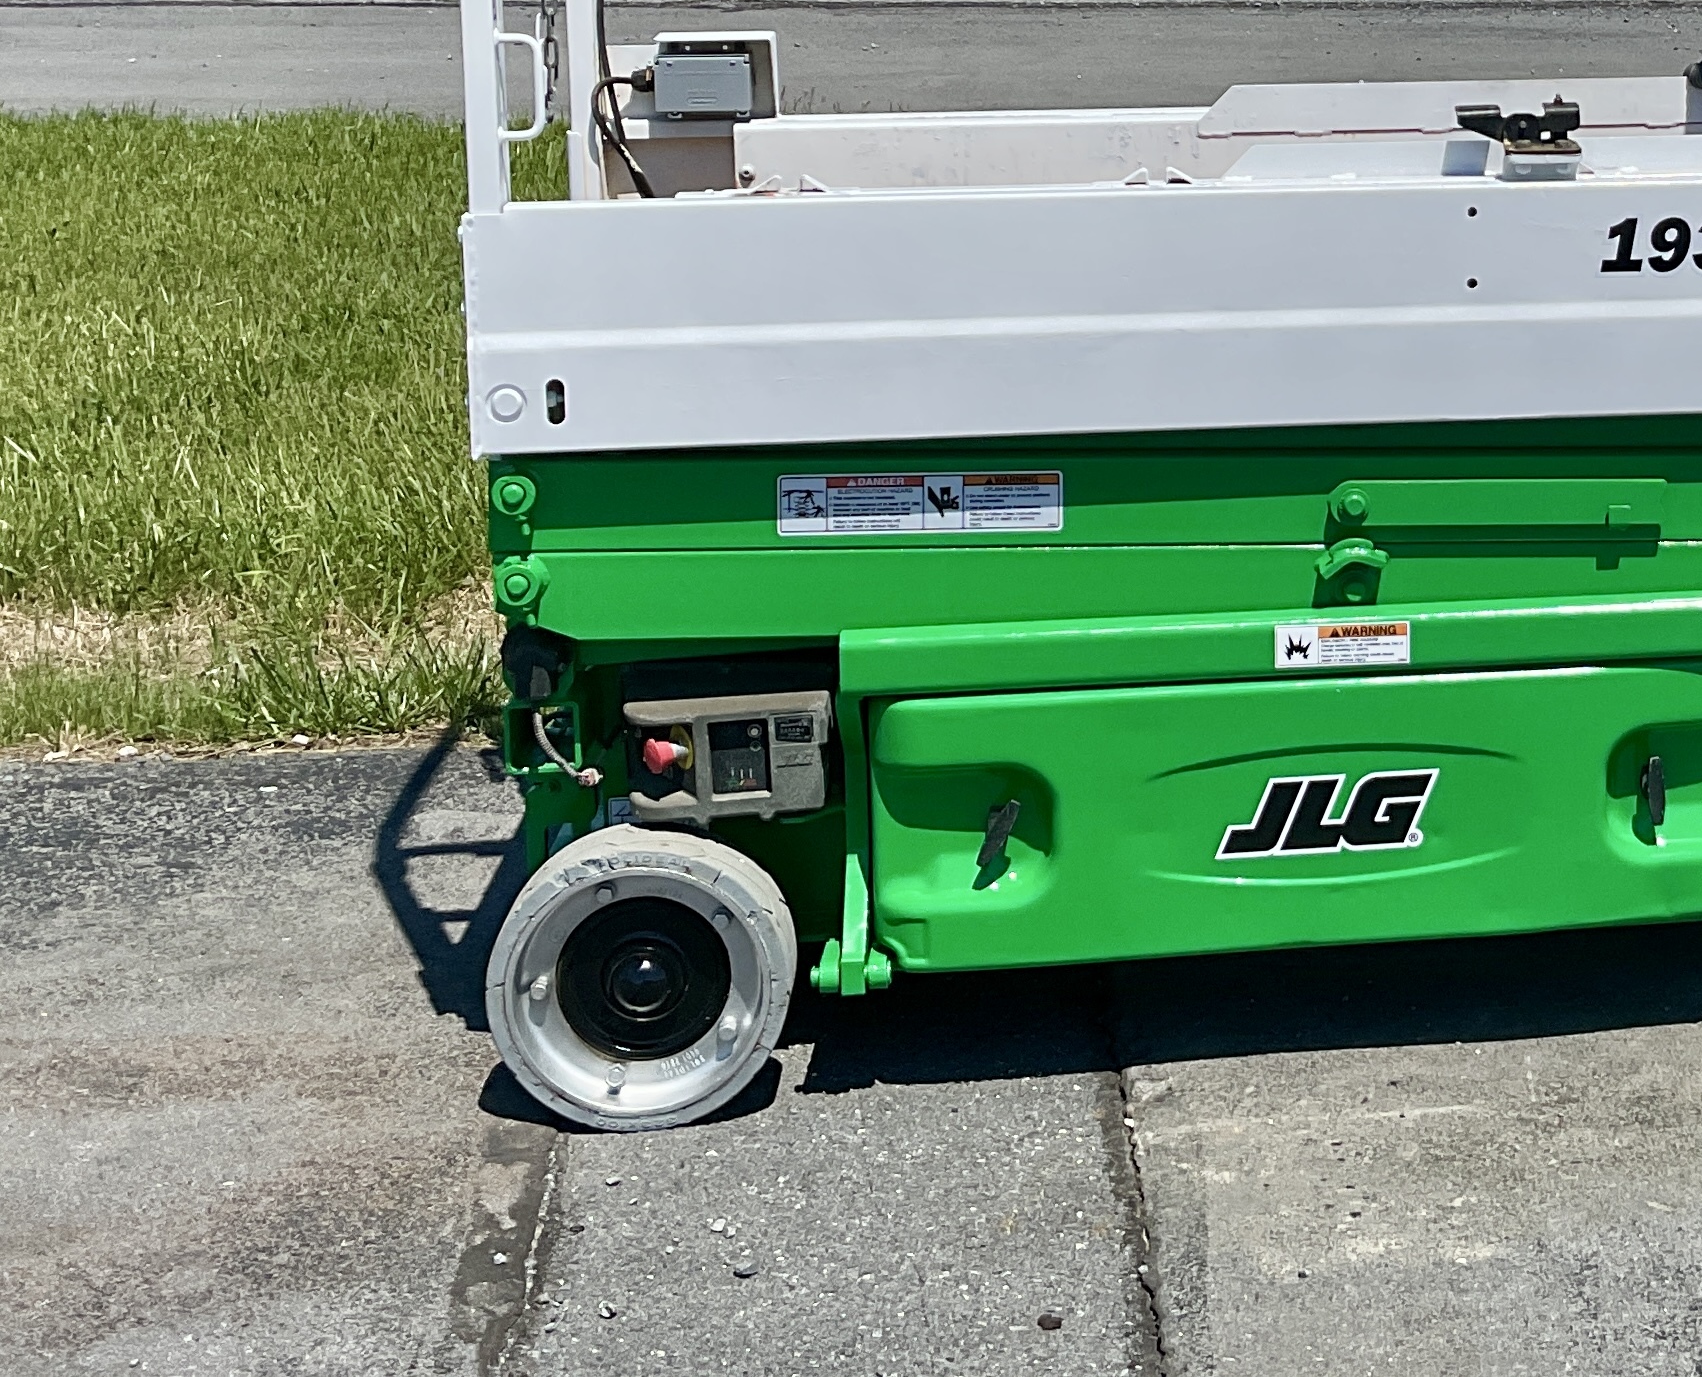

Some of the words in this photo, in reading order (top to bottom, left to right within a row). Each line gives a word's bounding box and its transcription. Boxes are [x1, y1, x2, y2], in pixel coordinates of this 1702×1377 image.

[857, 477, 905, 486] DANGER
[1341, 624, 1397, 637] WARNING
[1217, 770, 1438, 858] JLG
